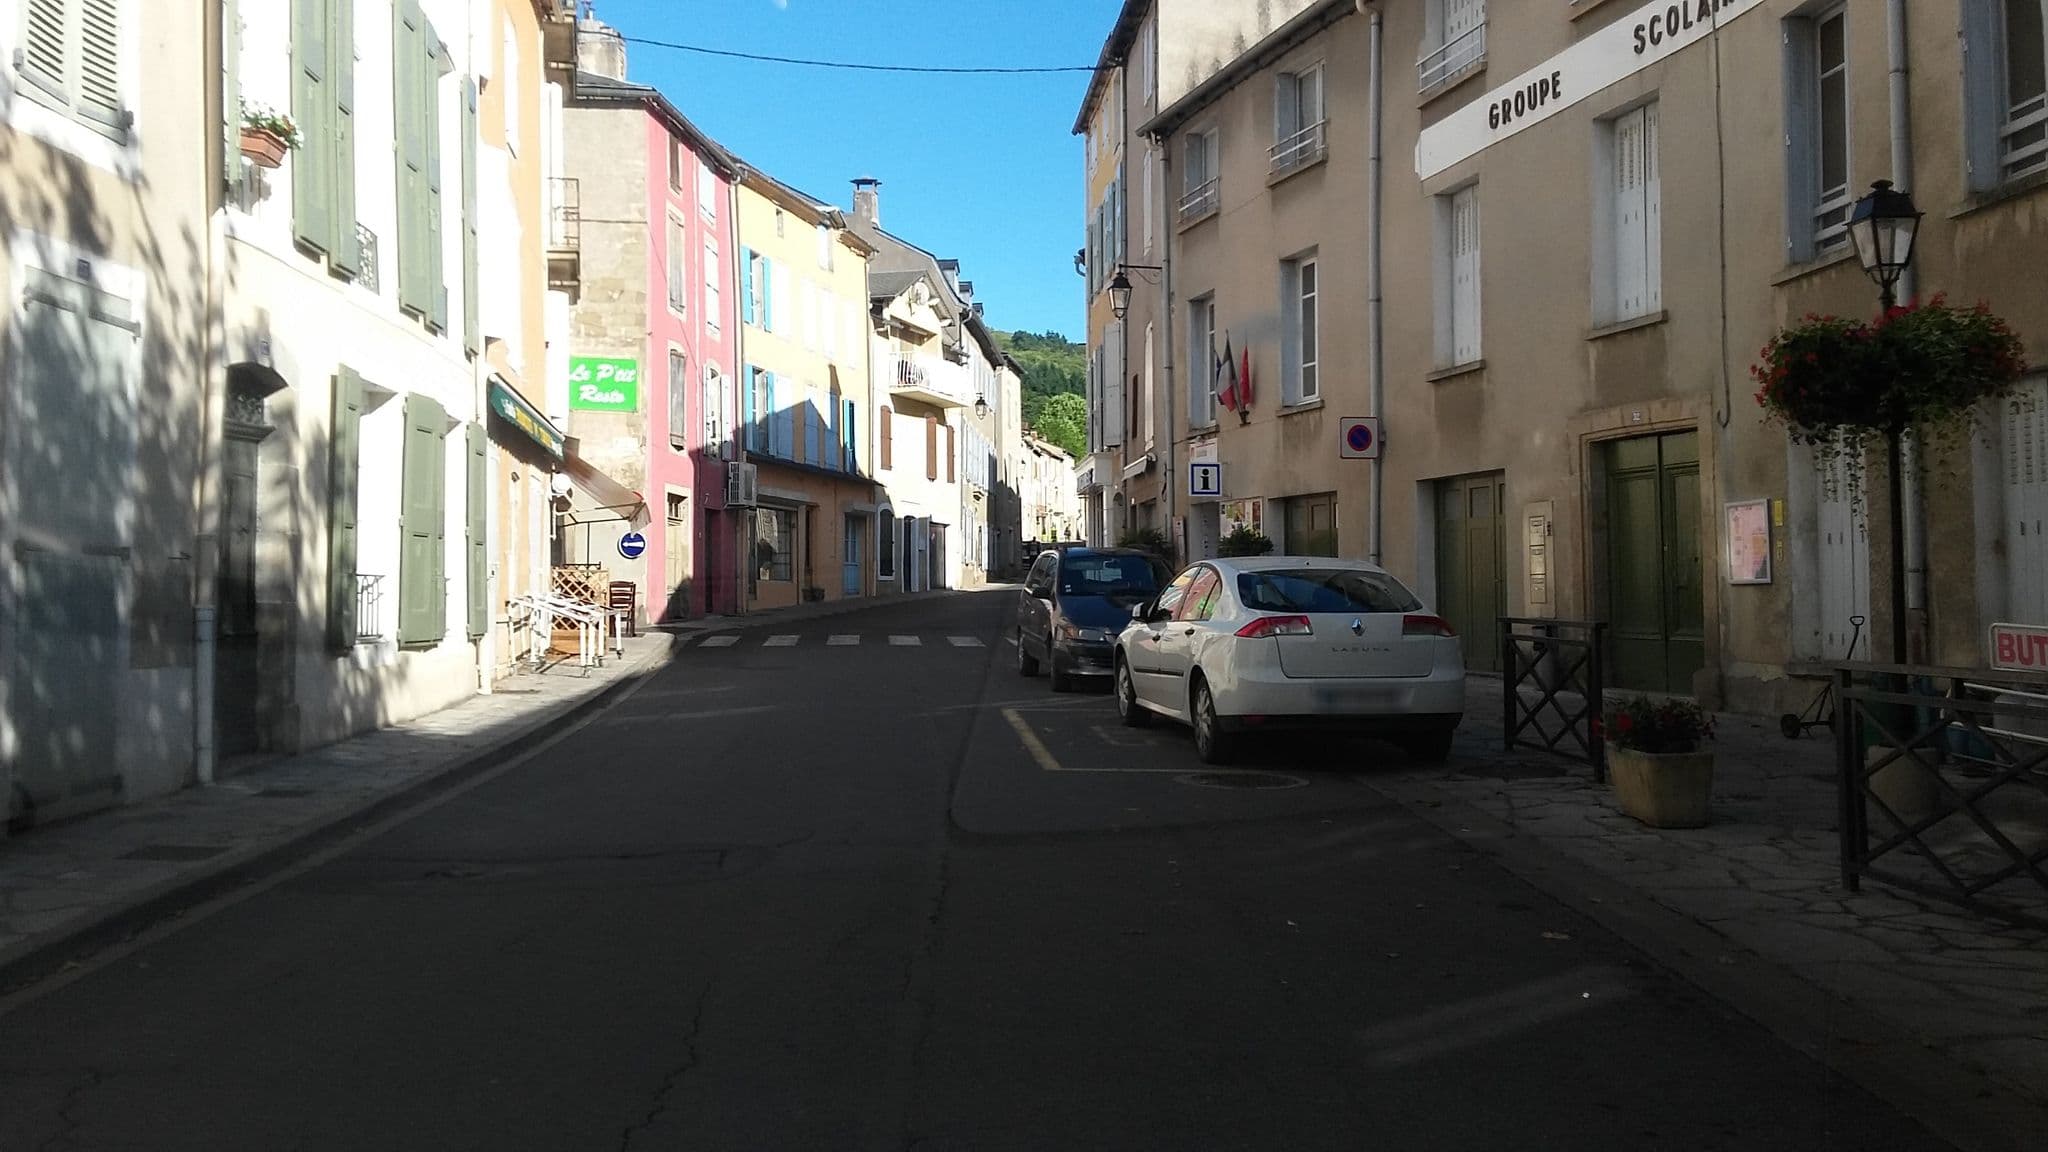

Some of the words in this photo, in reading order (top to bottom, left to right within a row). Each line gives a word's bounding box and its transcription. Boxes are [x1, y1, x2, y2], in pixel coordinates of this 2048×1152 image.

[1489, 71, 1561, 129] GROUPE
[1633, 0, 1735, 54] SCOLA
[570, 364, 591, 381] Le
[596, 363, 636, 382] P'tit
[1998, 633, 2048, 666] BUT
